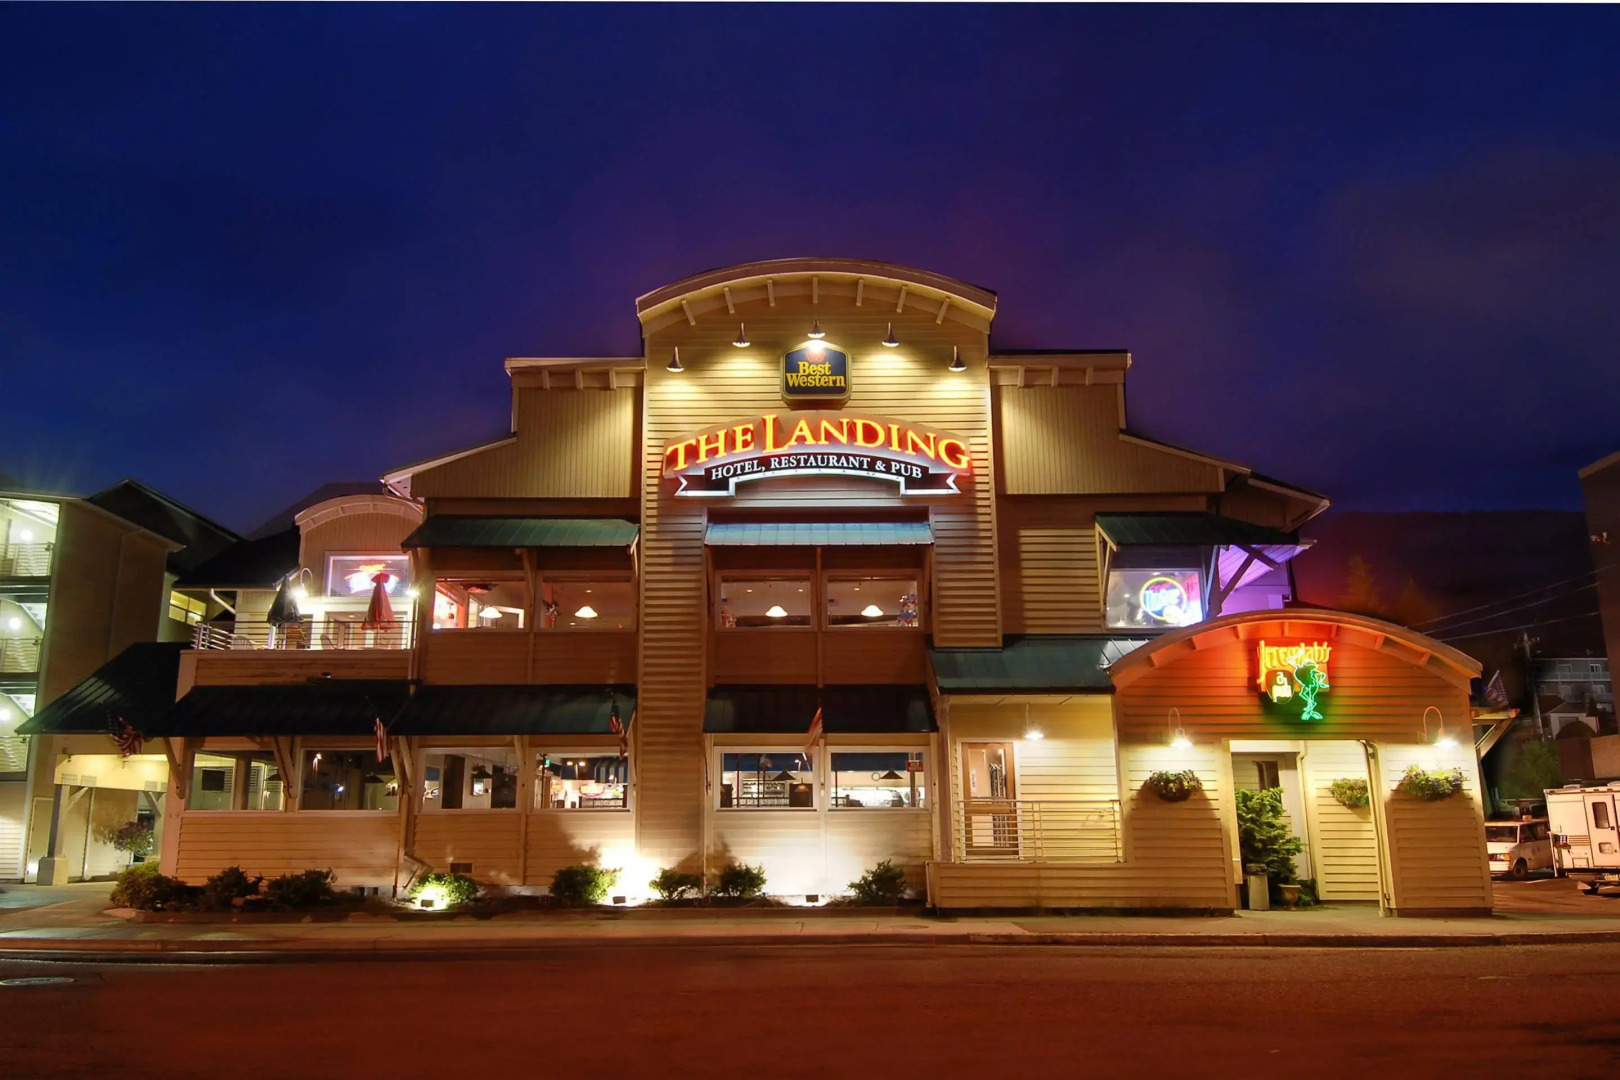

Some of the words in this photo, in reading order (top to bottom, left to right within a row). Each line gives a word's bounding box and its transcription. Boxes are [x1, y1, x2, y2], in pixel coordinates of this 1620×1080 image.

[798, 361, 831, 375] Best
[785, 373, 846, 387] Western
[666, 423, 755, 471] THE
[761, 414, 970, 470] LANDING
[711, 460, 765, 480] HOTEL,
[770, 455, 871, 470] RESTAURANT
[875, 459, 886, 472] &
[890, 461, 923, 478] PUB
